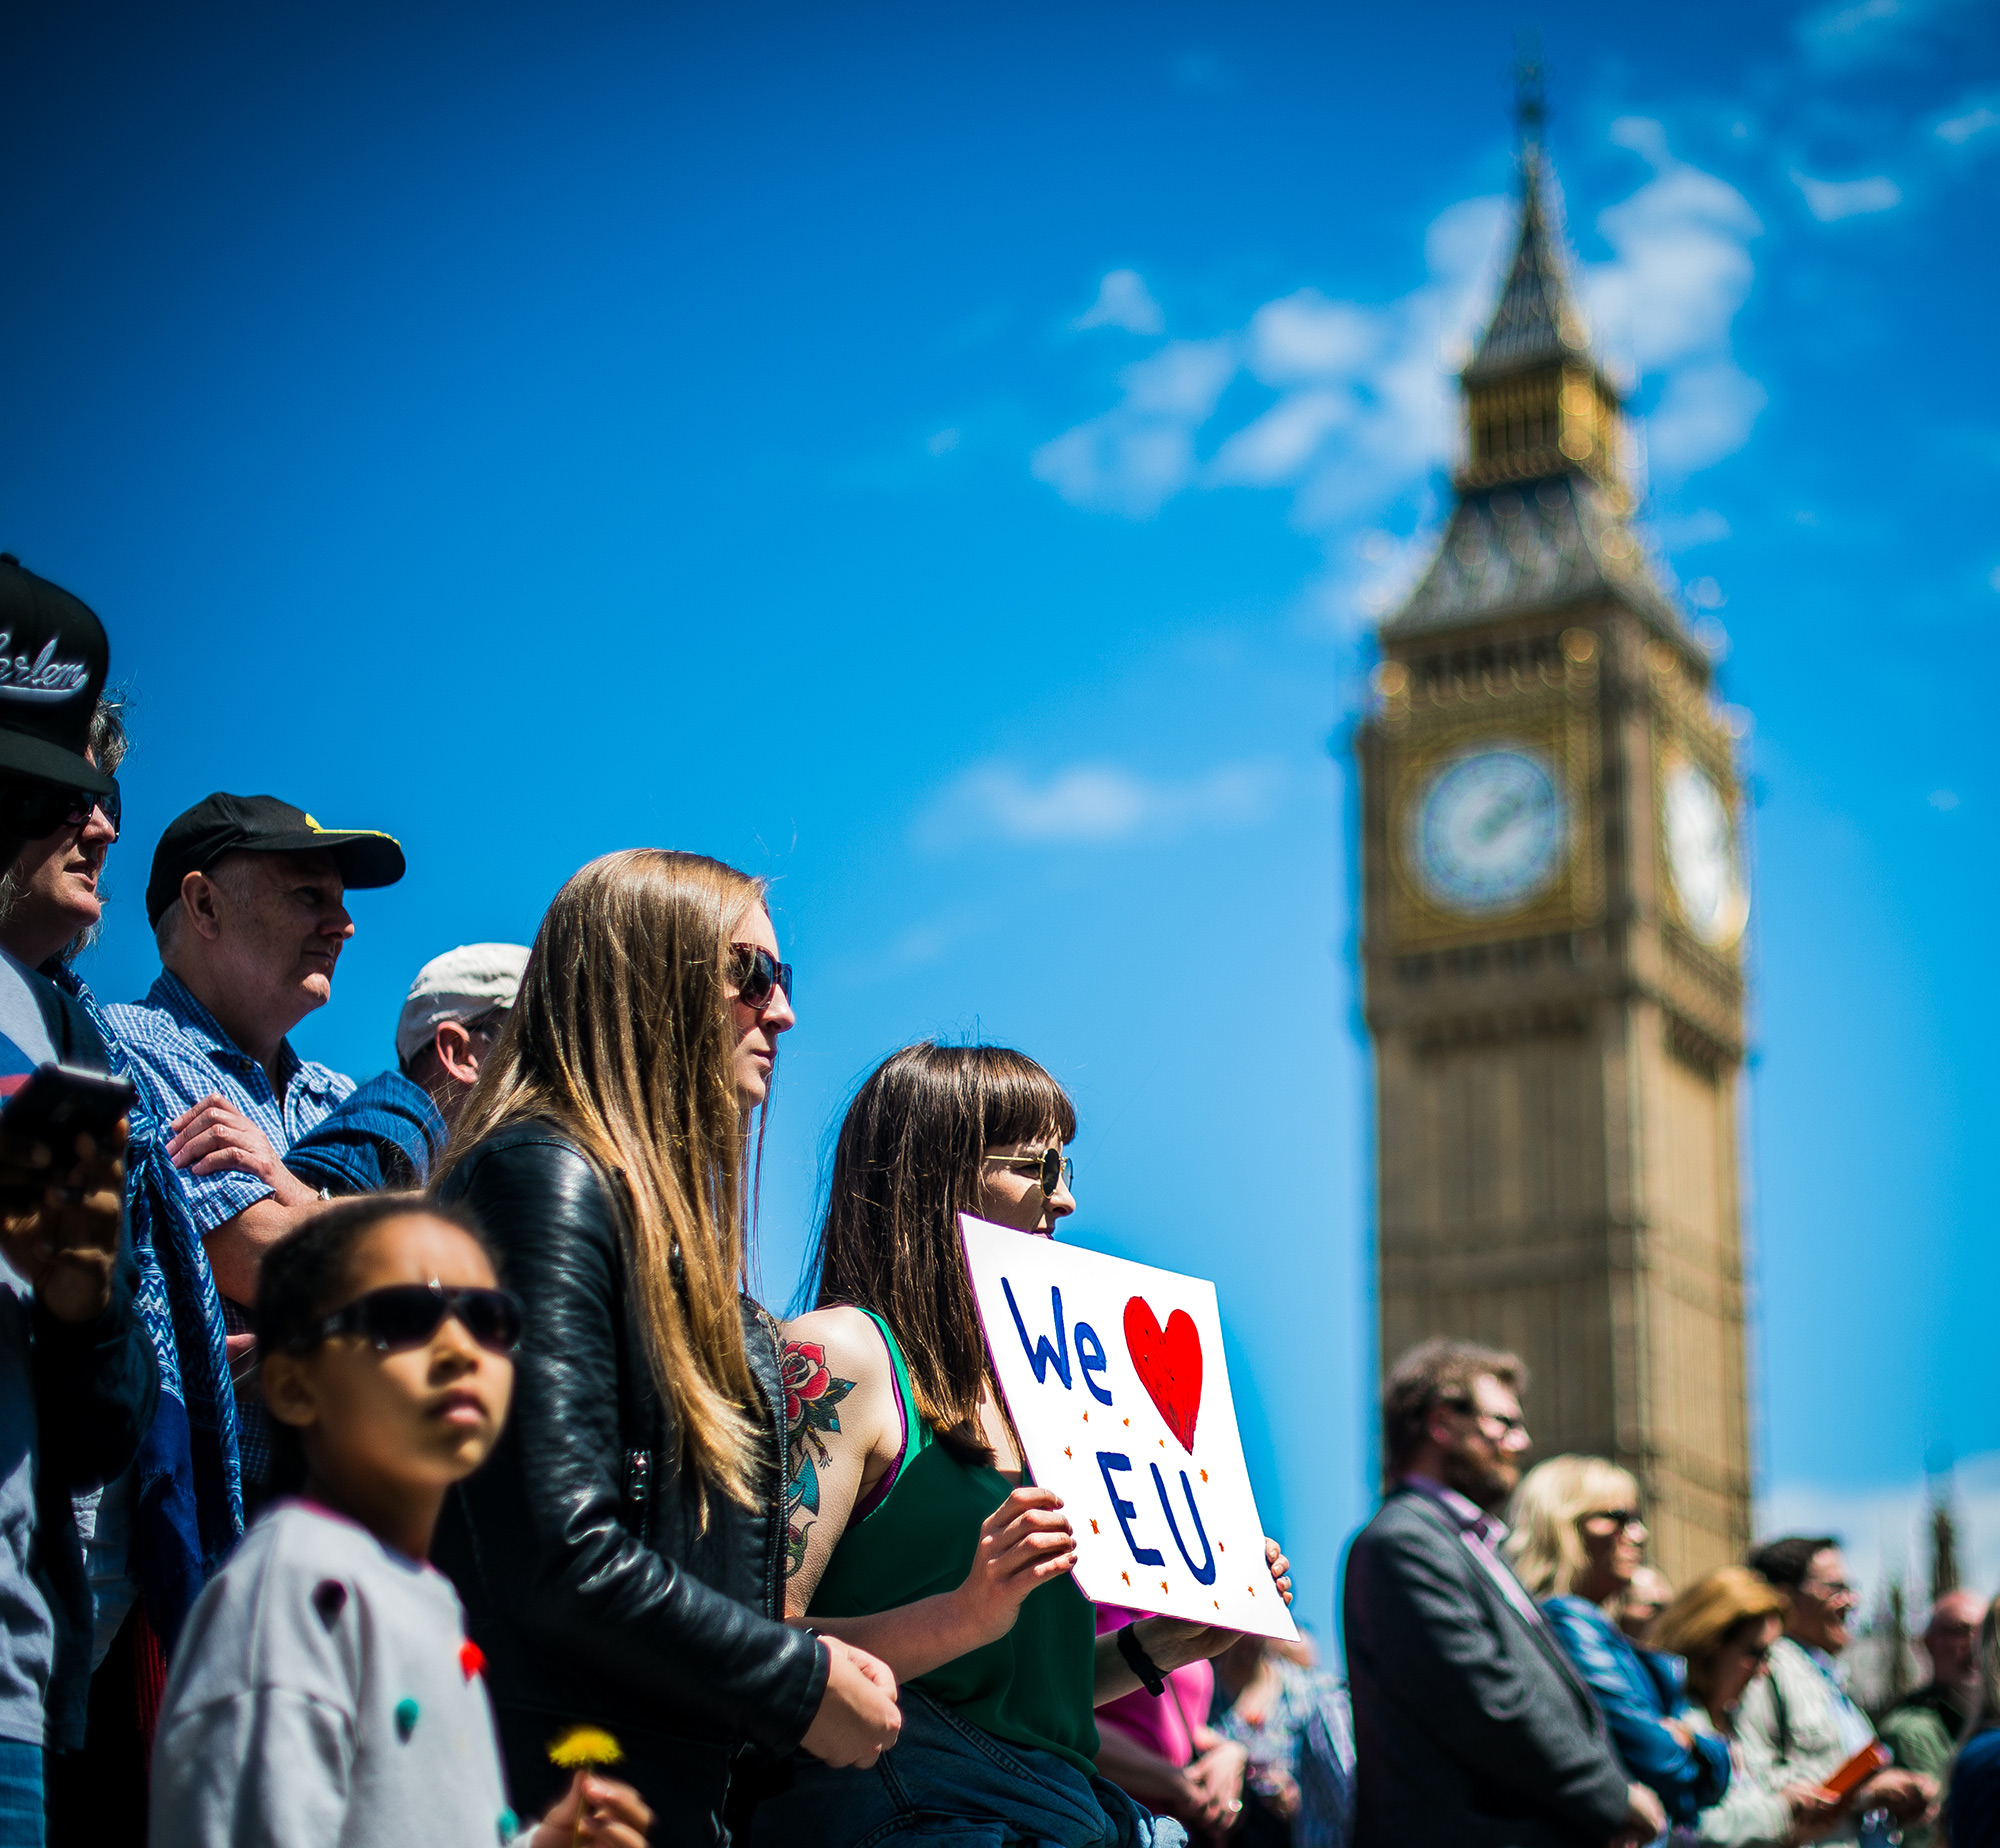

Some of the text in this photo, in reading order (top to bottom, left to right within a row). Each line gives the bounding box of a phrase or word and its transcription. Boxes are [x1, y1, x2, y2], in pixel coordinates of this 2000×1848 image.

[0, 632, 88, 692] arlem
[1000, 1276, 1113, 1407] We
[1096, 1451, 1217, 1586] EU
